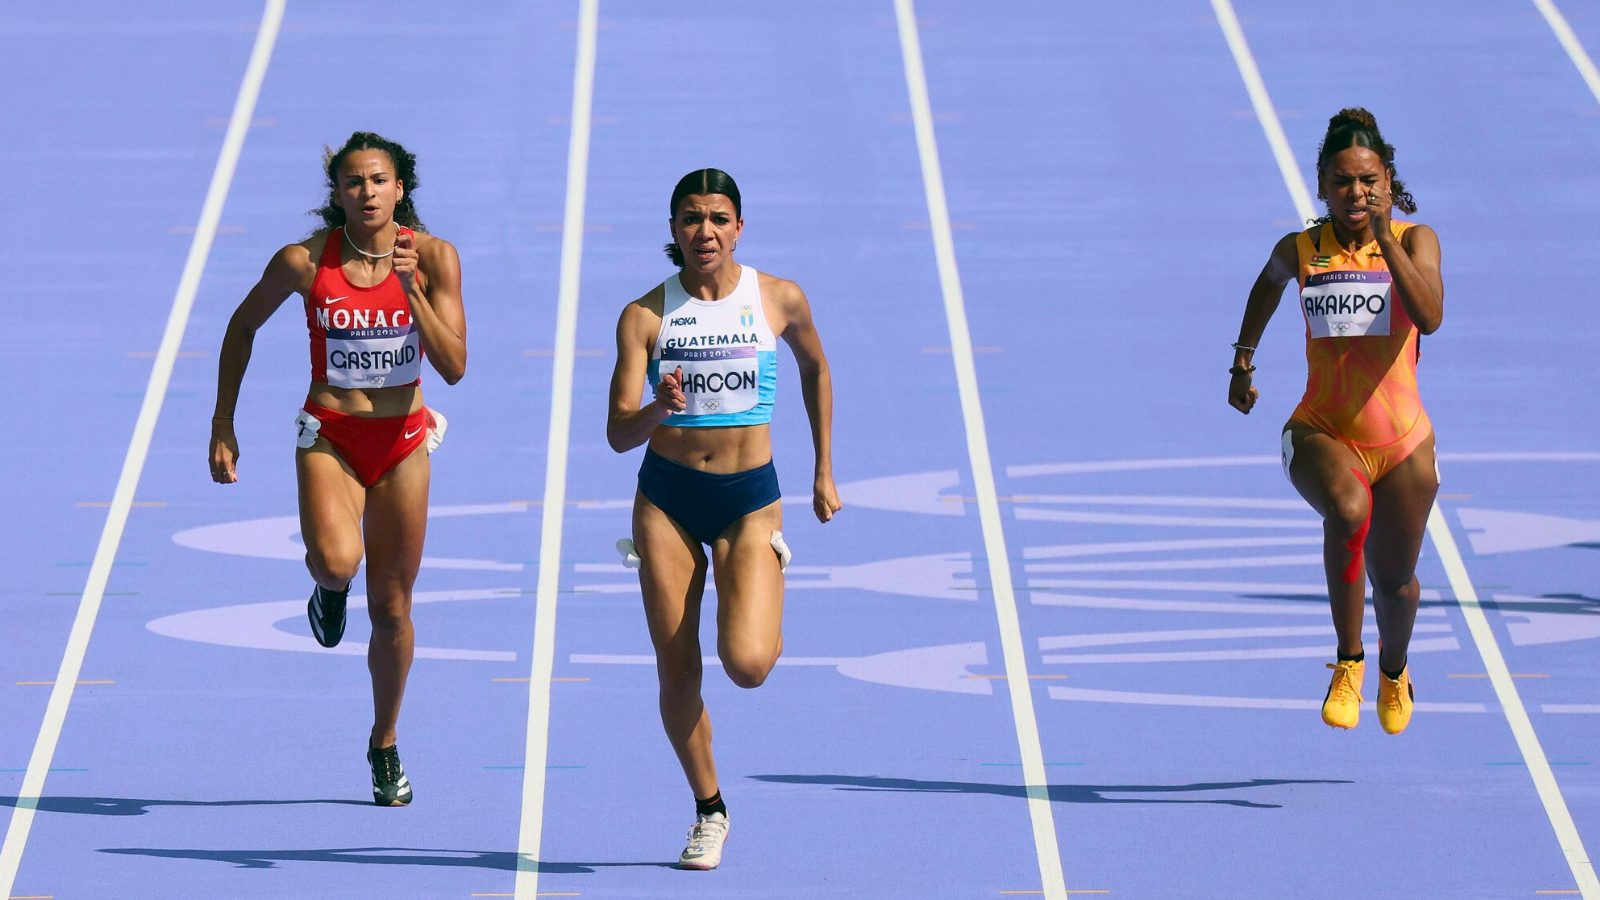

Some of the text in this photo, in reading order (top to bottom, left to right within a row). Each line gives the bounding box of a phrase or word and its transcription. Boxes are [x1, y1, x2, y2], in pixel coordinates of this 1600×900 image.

[1304, 294, 1386, 317] AKAKPO
[316, 307, 414, 331] MONAC
[670, 316, 697, 327] HOKA
[665, 333, 758, 351] GUATEMALA
[330, 345, 416, 370] GASTAUD
[667, 370, 756, 394] HACON
